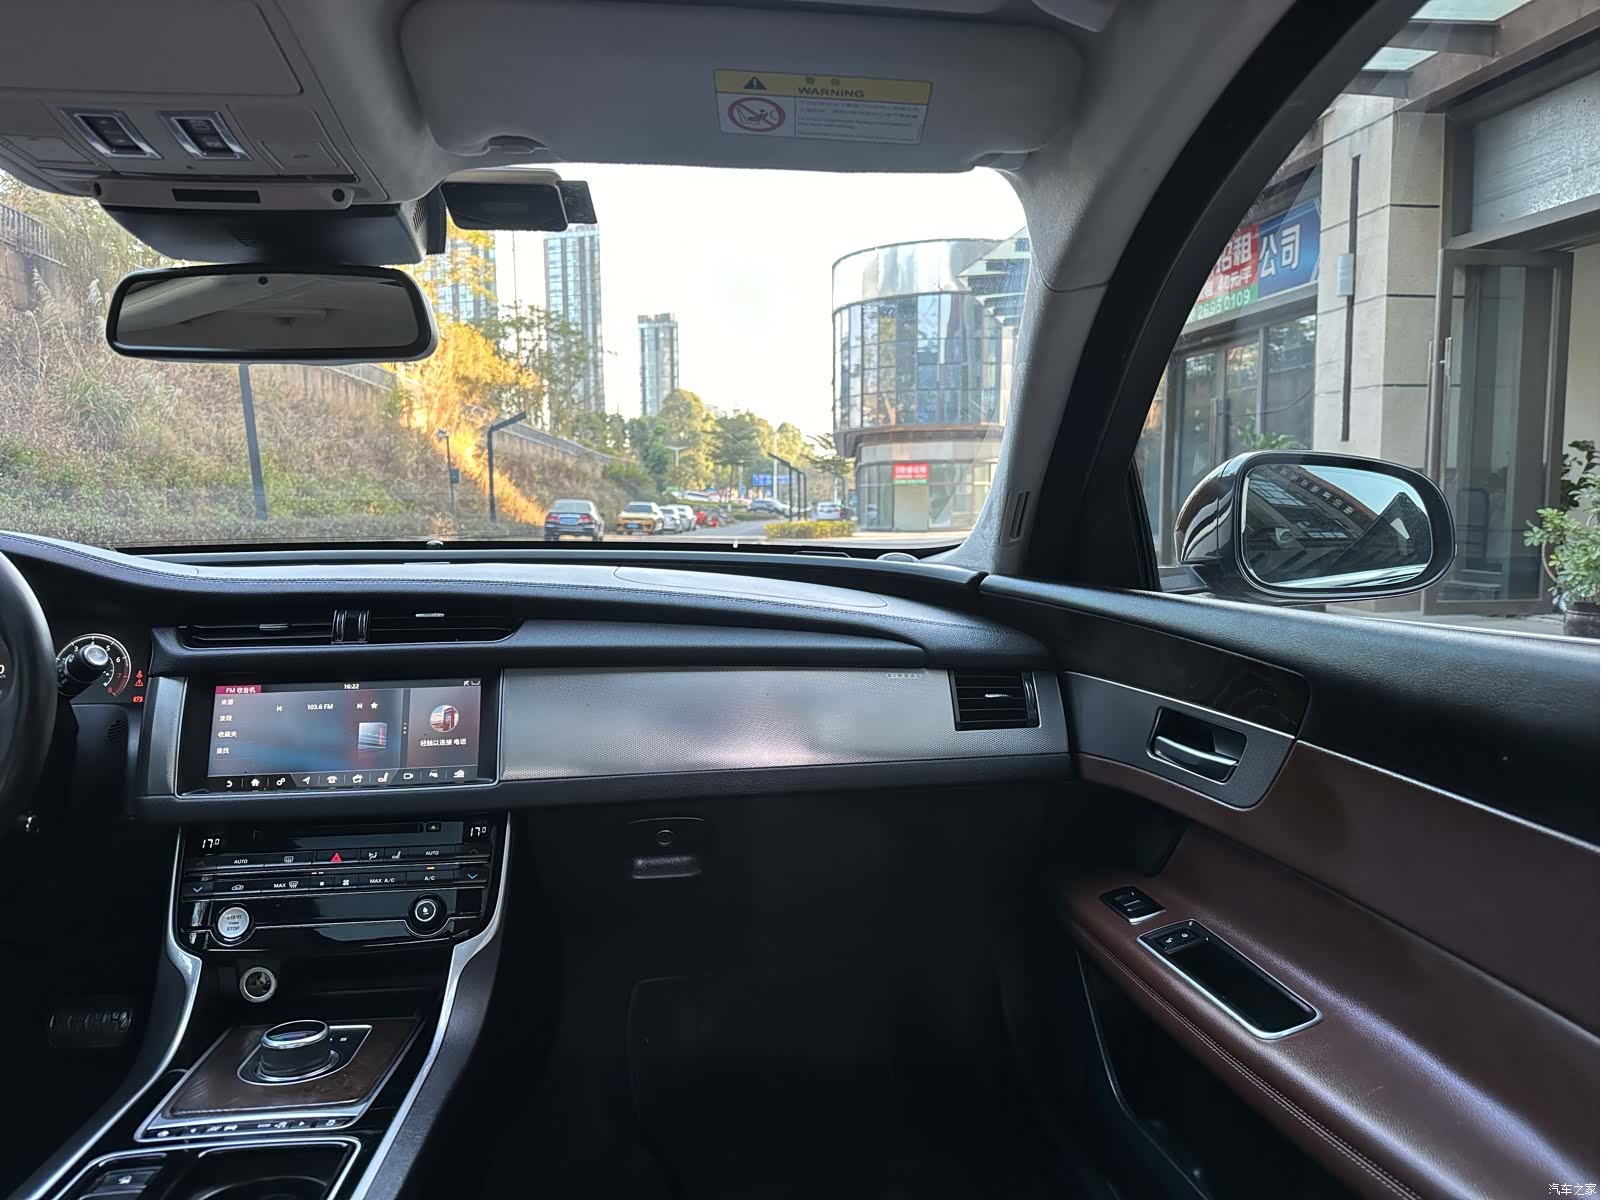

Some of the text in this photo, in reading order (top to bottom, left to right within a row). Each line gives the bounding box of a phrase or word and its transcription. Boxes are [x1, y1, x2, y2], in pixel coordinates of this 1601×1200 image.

[798, 87, 865, 98] WARNING
[1259, 224, 1301, 278] 公司
[237, 686, 256, 694] 收音机
[217, 730, 237, 738] 收藏夹
